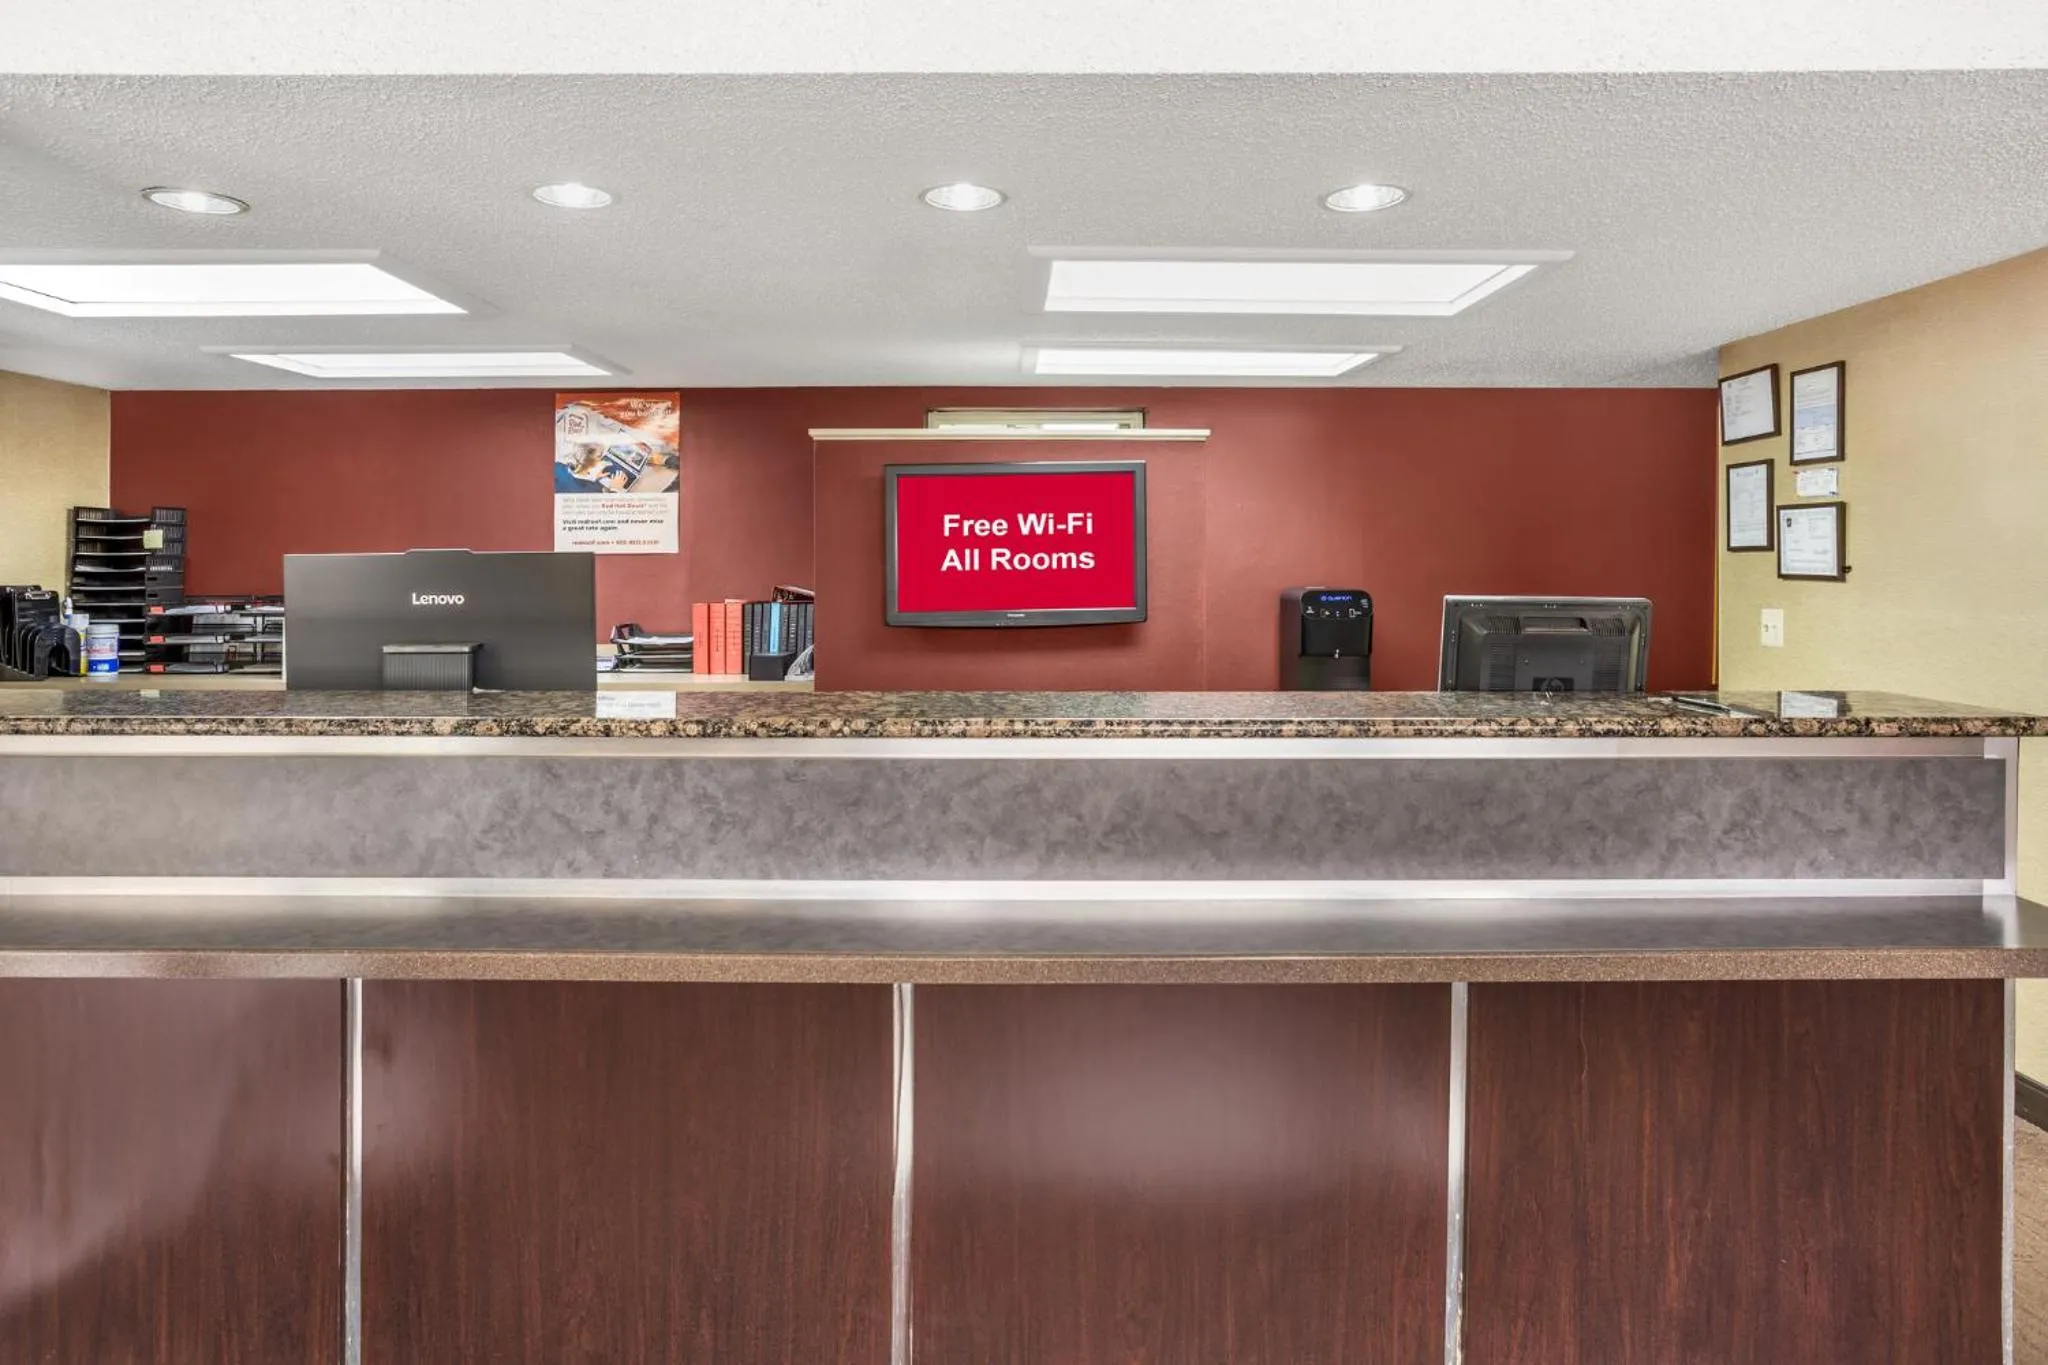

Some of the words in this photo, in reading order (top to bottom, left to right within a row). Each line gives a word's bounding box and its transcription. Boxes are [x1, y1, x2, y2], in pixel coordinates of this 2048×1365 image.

[943, 513, 1009, 537] Free
[1017, 512, 1094, 536] Wi-Fi
[941, 548, 980, 571] All
[990, 548, 1096, 571] Rooms
[411, 592, 465, 605] Lenovo
